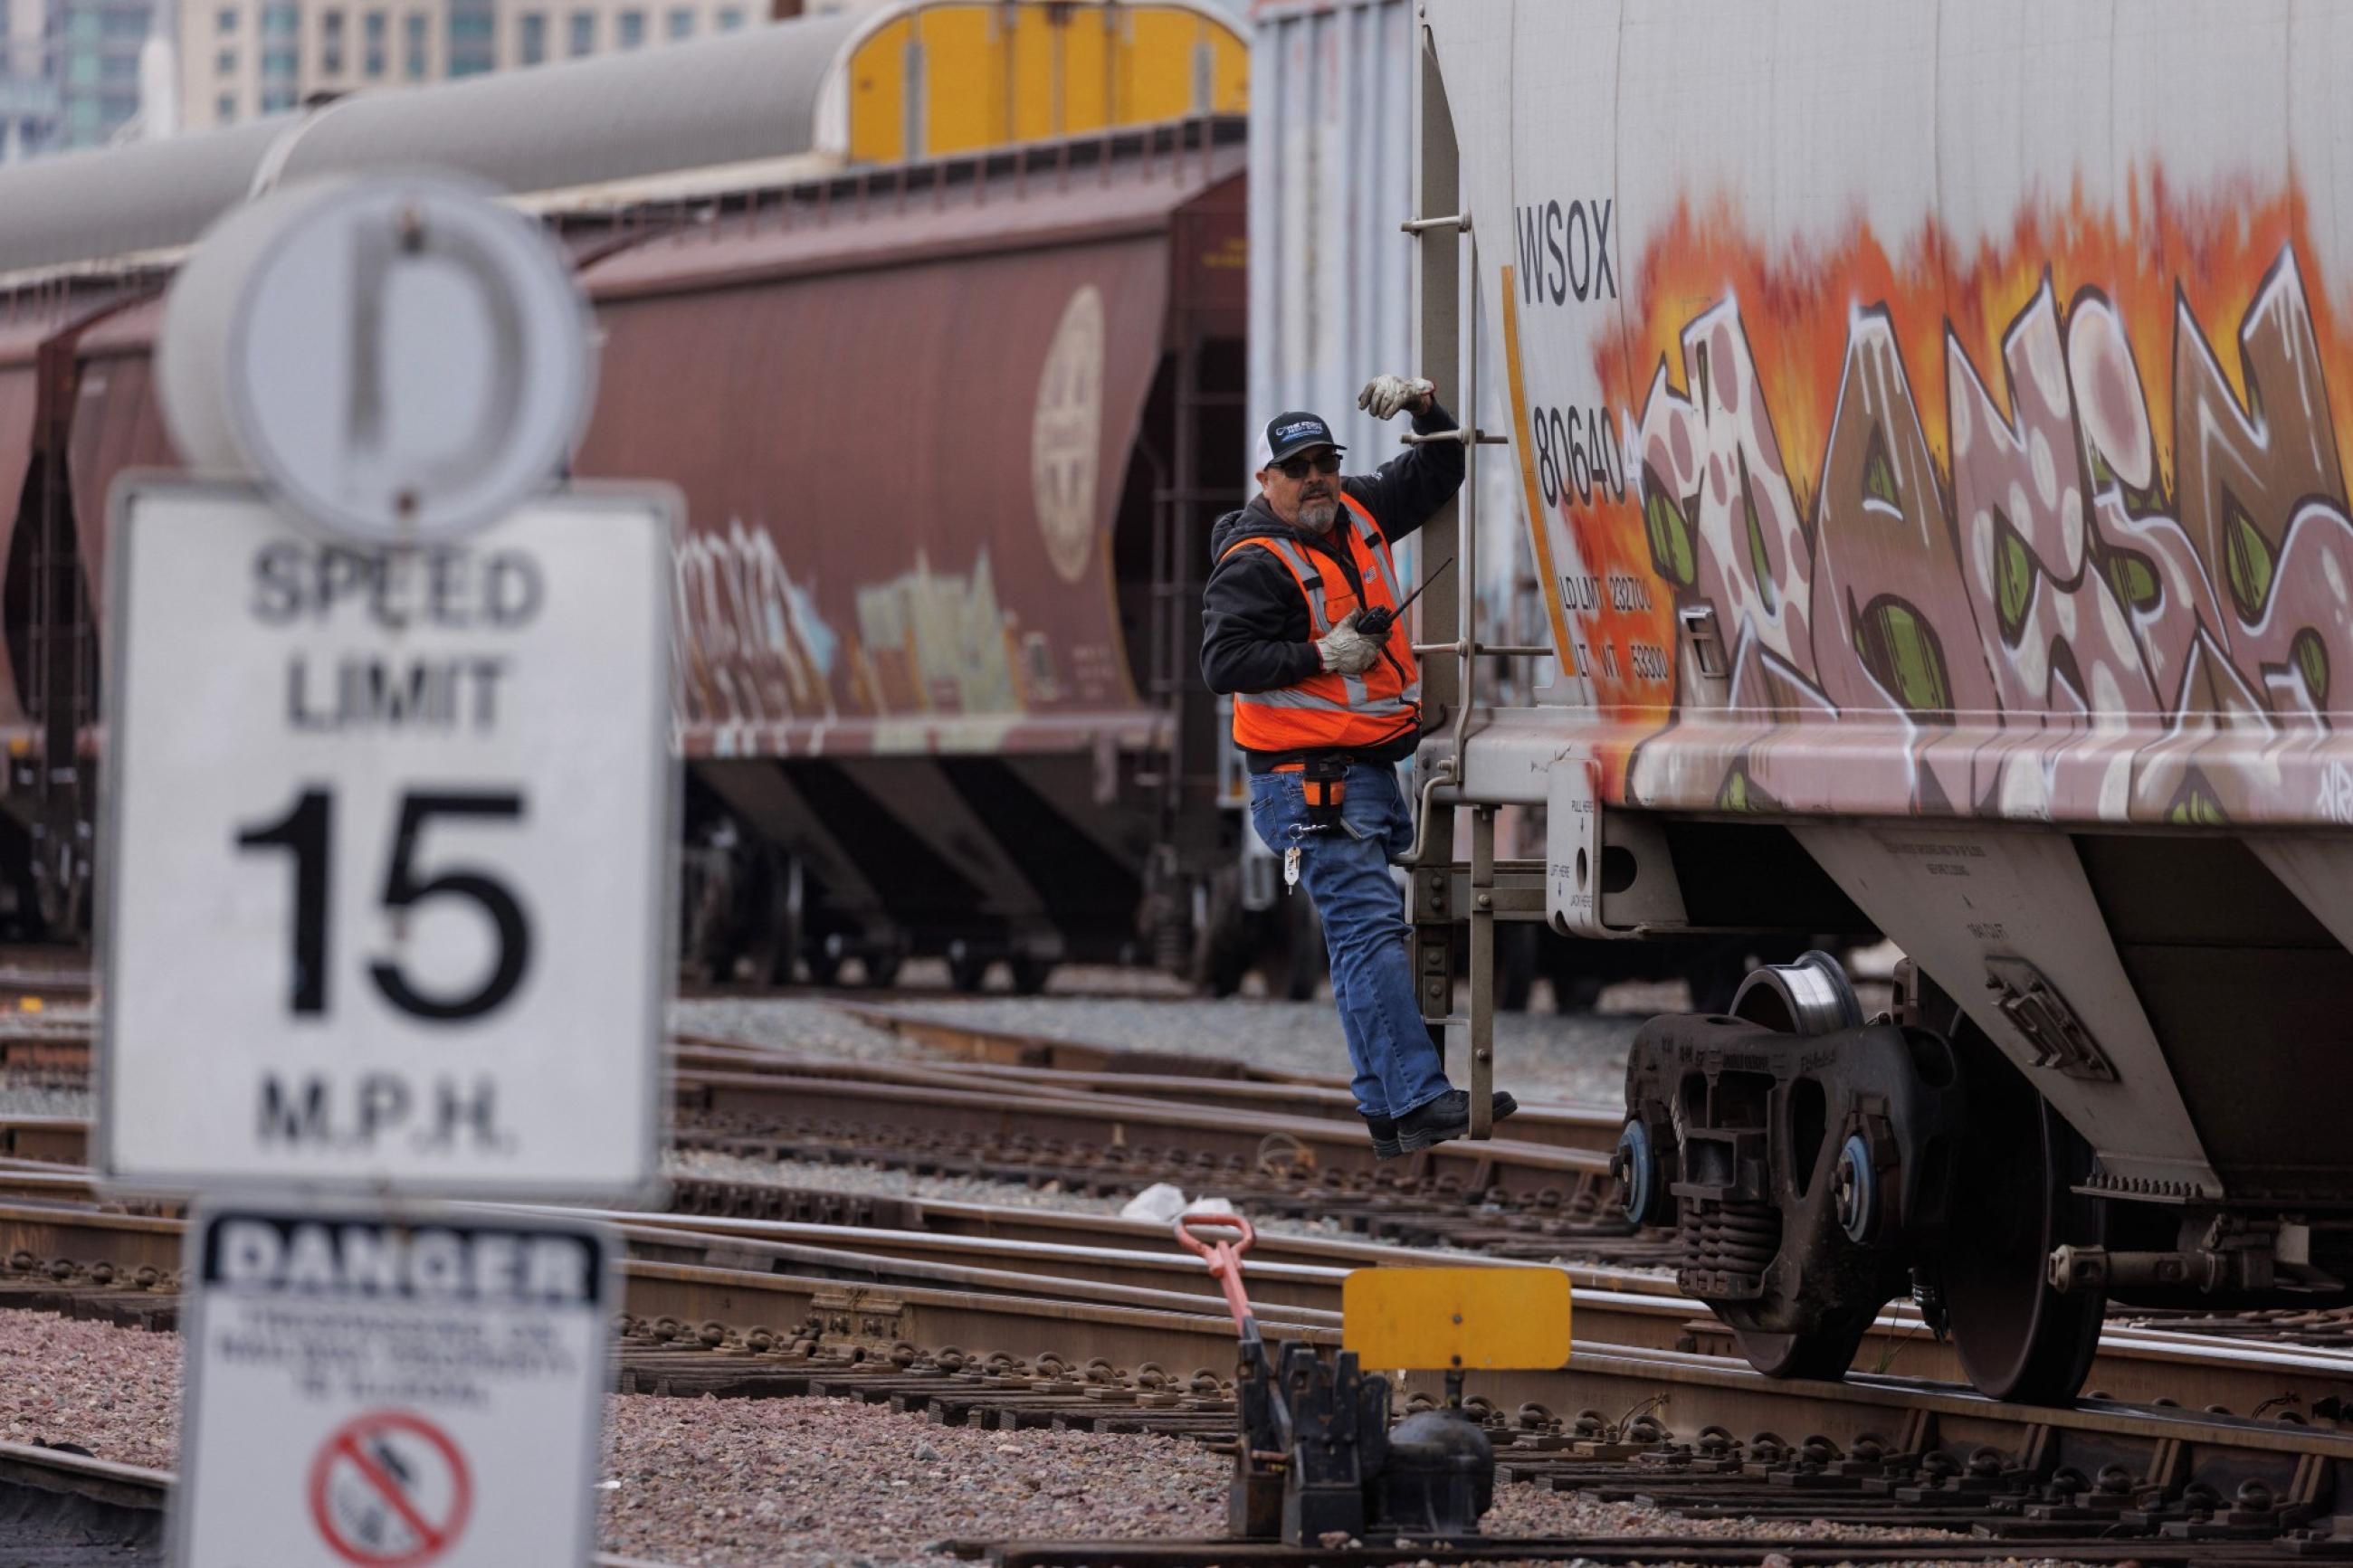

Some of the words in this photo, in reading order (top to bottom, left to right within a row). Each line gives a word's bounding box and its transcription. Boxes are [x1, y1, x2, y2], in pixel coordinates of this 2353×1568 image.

[1516, 198, 1617, 307] WSOX
[1534, 404, 1625, 508] 80640
[250, 542, 545, 631] SPEED
[1558, 576, 1577, 610] LD
[1576, 576, 1604, 610] LMT
[287, 655, 514, 735] LIMIT
[1575, 643, 1590, 678] LT
[1597, 643, 1620, 678] WT
[1630, 645, 1668, 679] 53300
[1571, 800, 1582, 813] PULL
[236, 783, 530, 1028] 15
[257, 1073, 515, 1156] M.P.H.
[221, 1220, 584, 1297] DANGER
